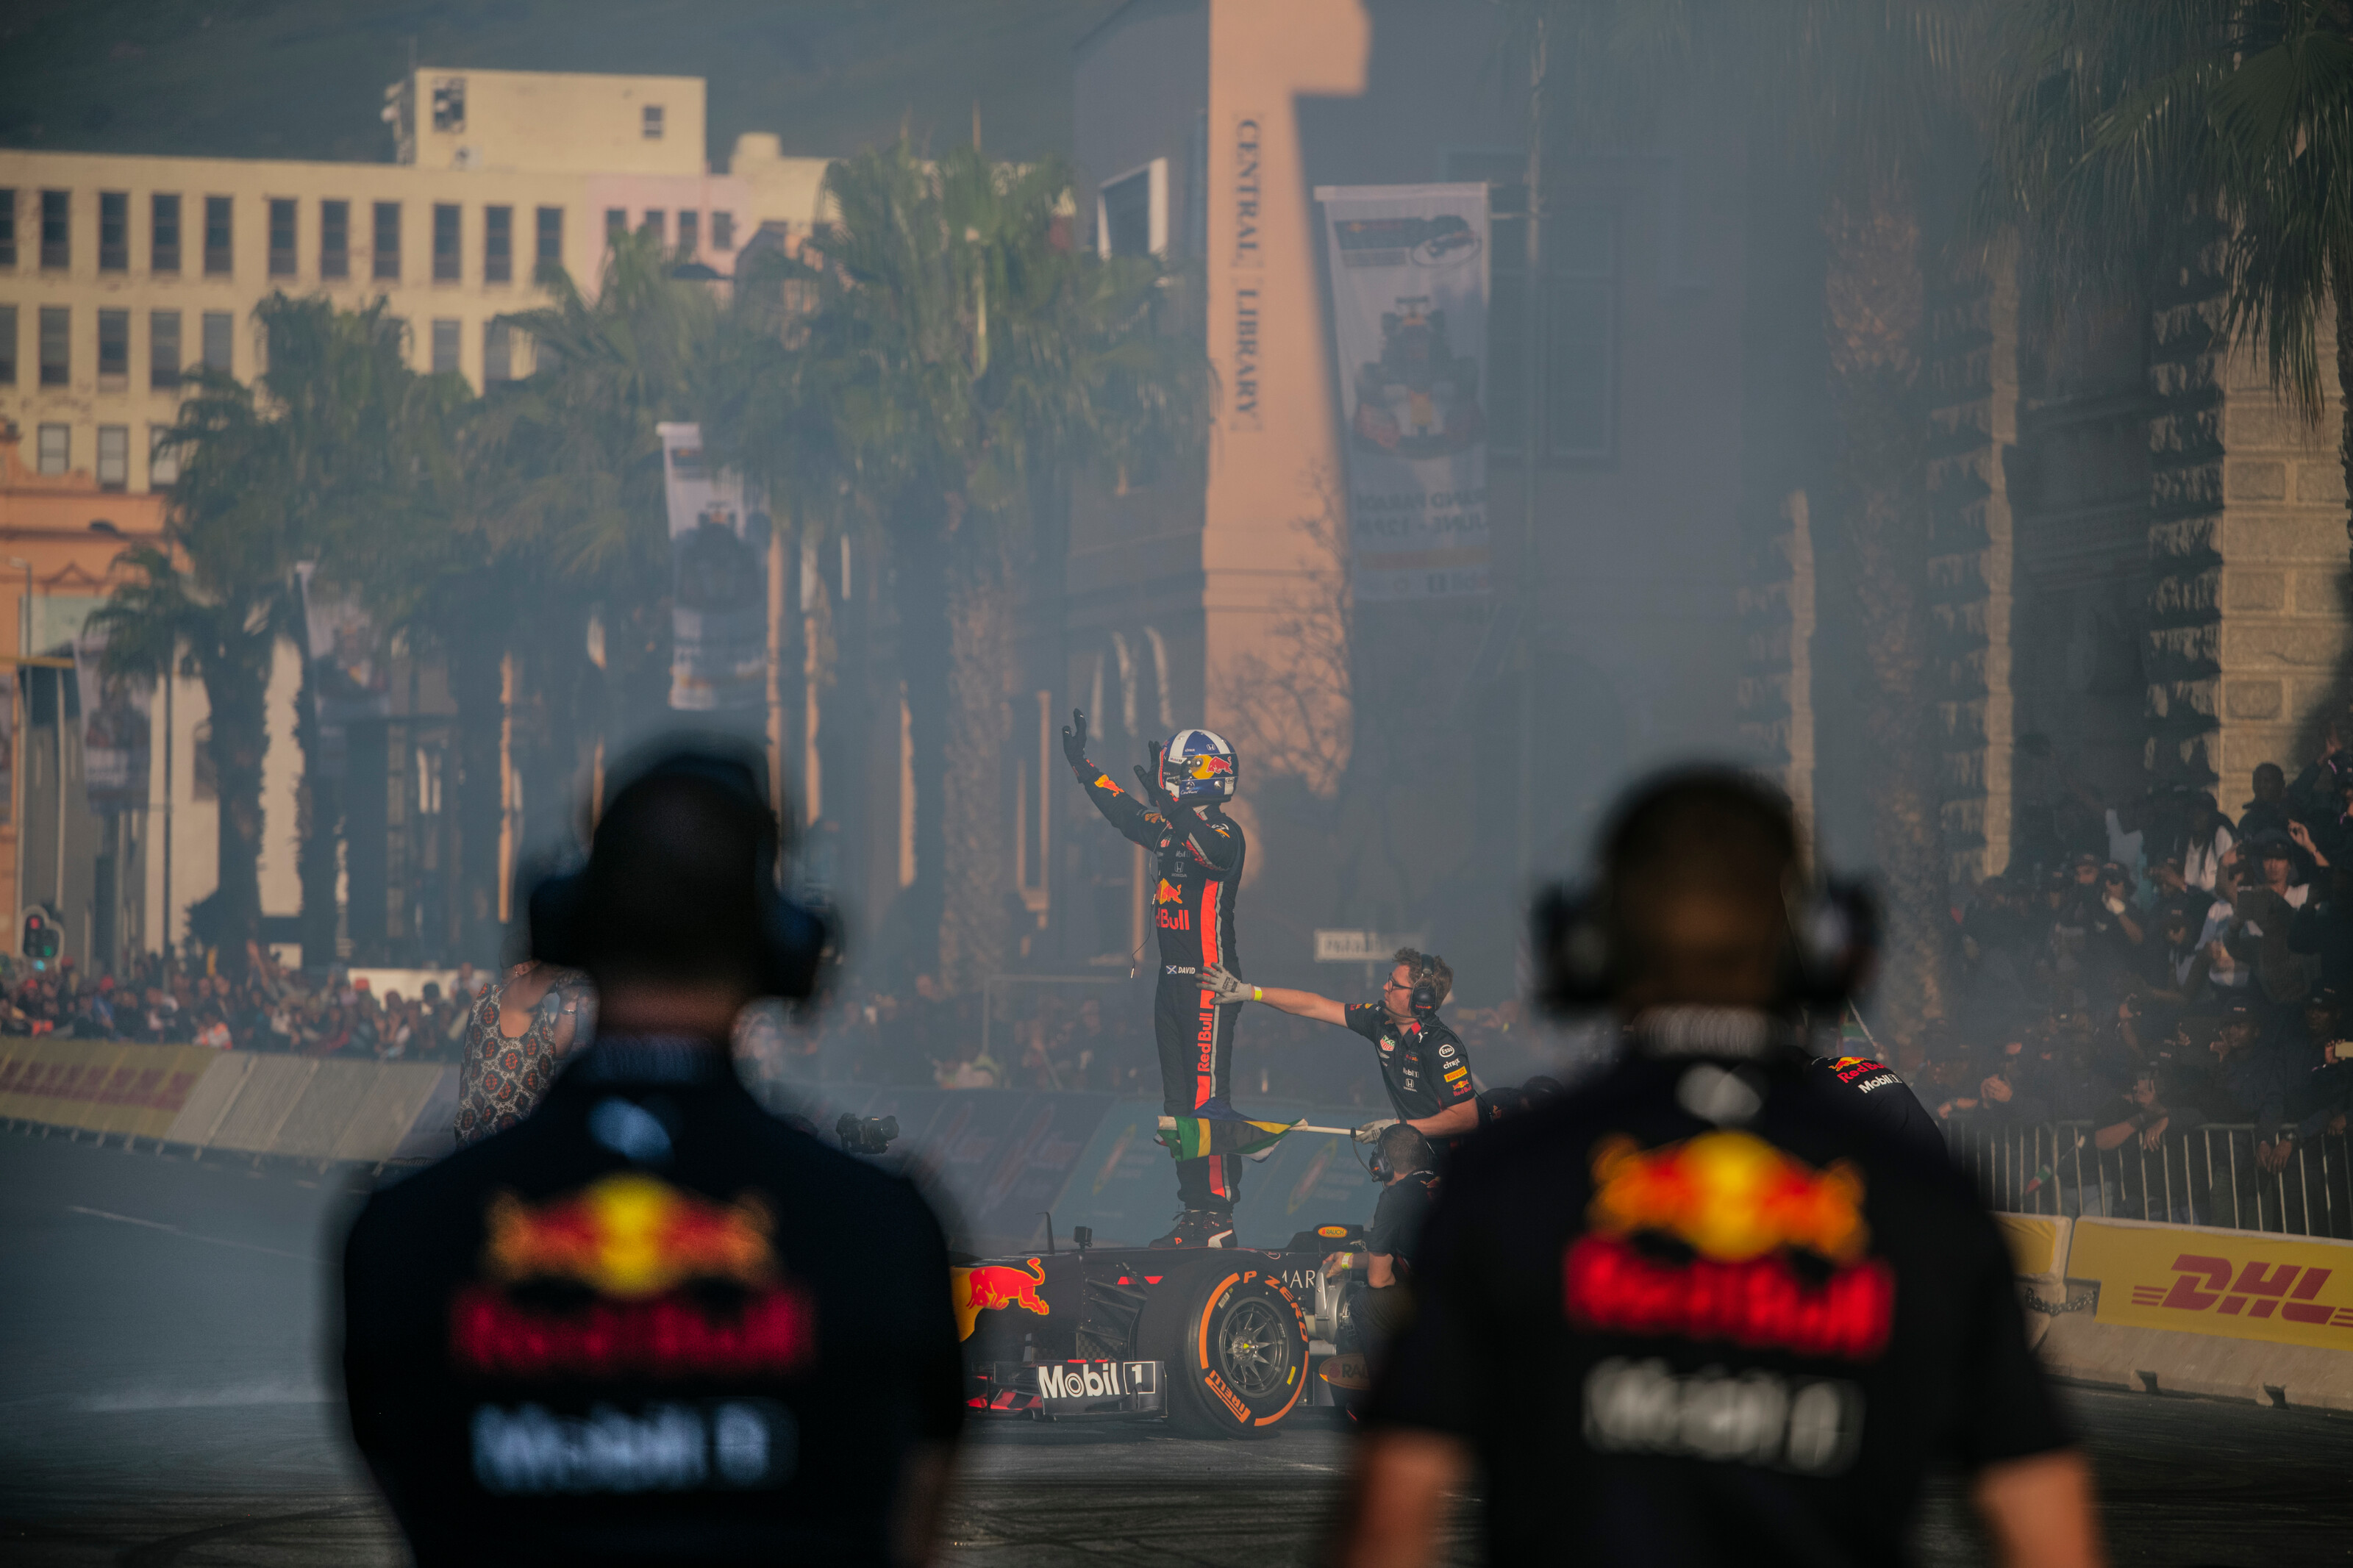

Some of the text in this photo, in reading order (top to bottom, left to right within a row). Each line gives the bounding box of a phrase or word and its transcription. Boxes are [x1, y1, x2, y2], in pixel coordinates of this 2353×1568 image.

[1235, 118, 1261, 418] CENTRAL LIBRARY
[1197, 1012, 1213, 1072] Red Bull
[1837, 1063, 1868, 1084] Red
[1857, 1074, 1893, 1094] Mobil
[1243, 1270, 1257, 1284] P
[1265, 1275, 1309, 1343] ZERO
[2160, 1253, 2333, 1325] DHL
[1038, 1362, 1121, 1399] Mobil
[1204, 1370, 1252, 1423] PIRELLI
